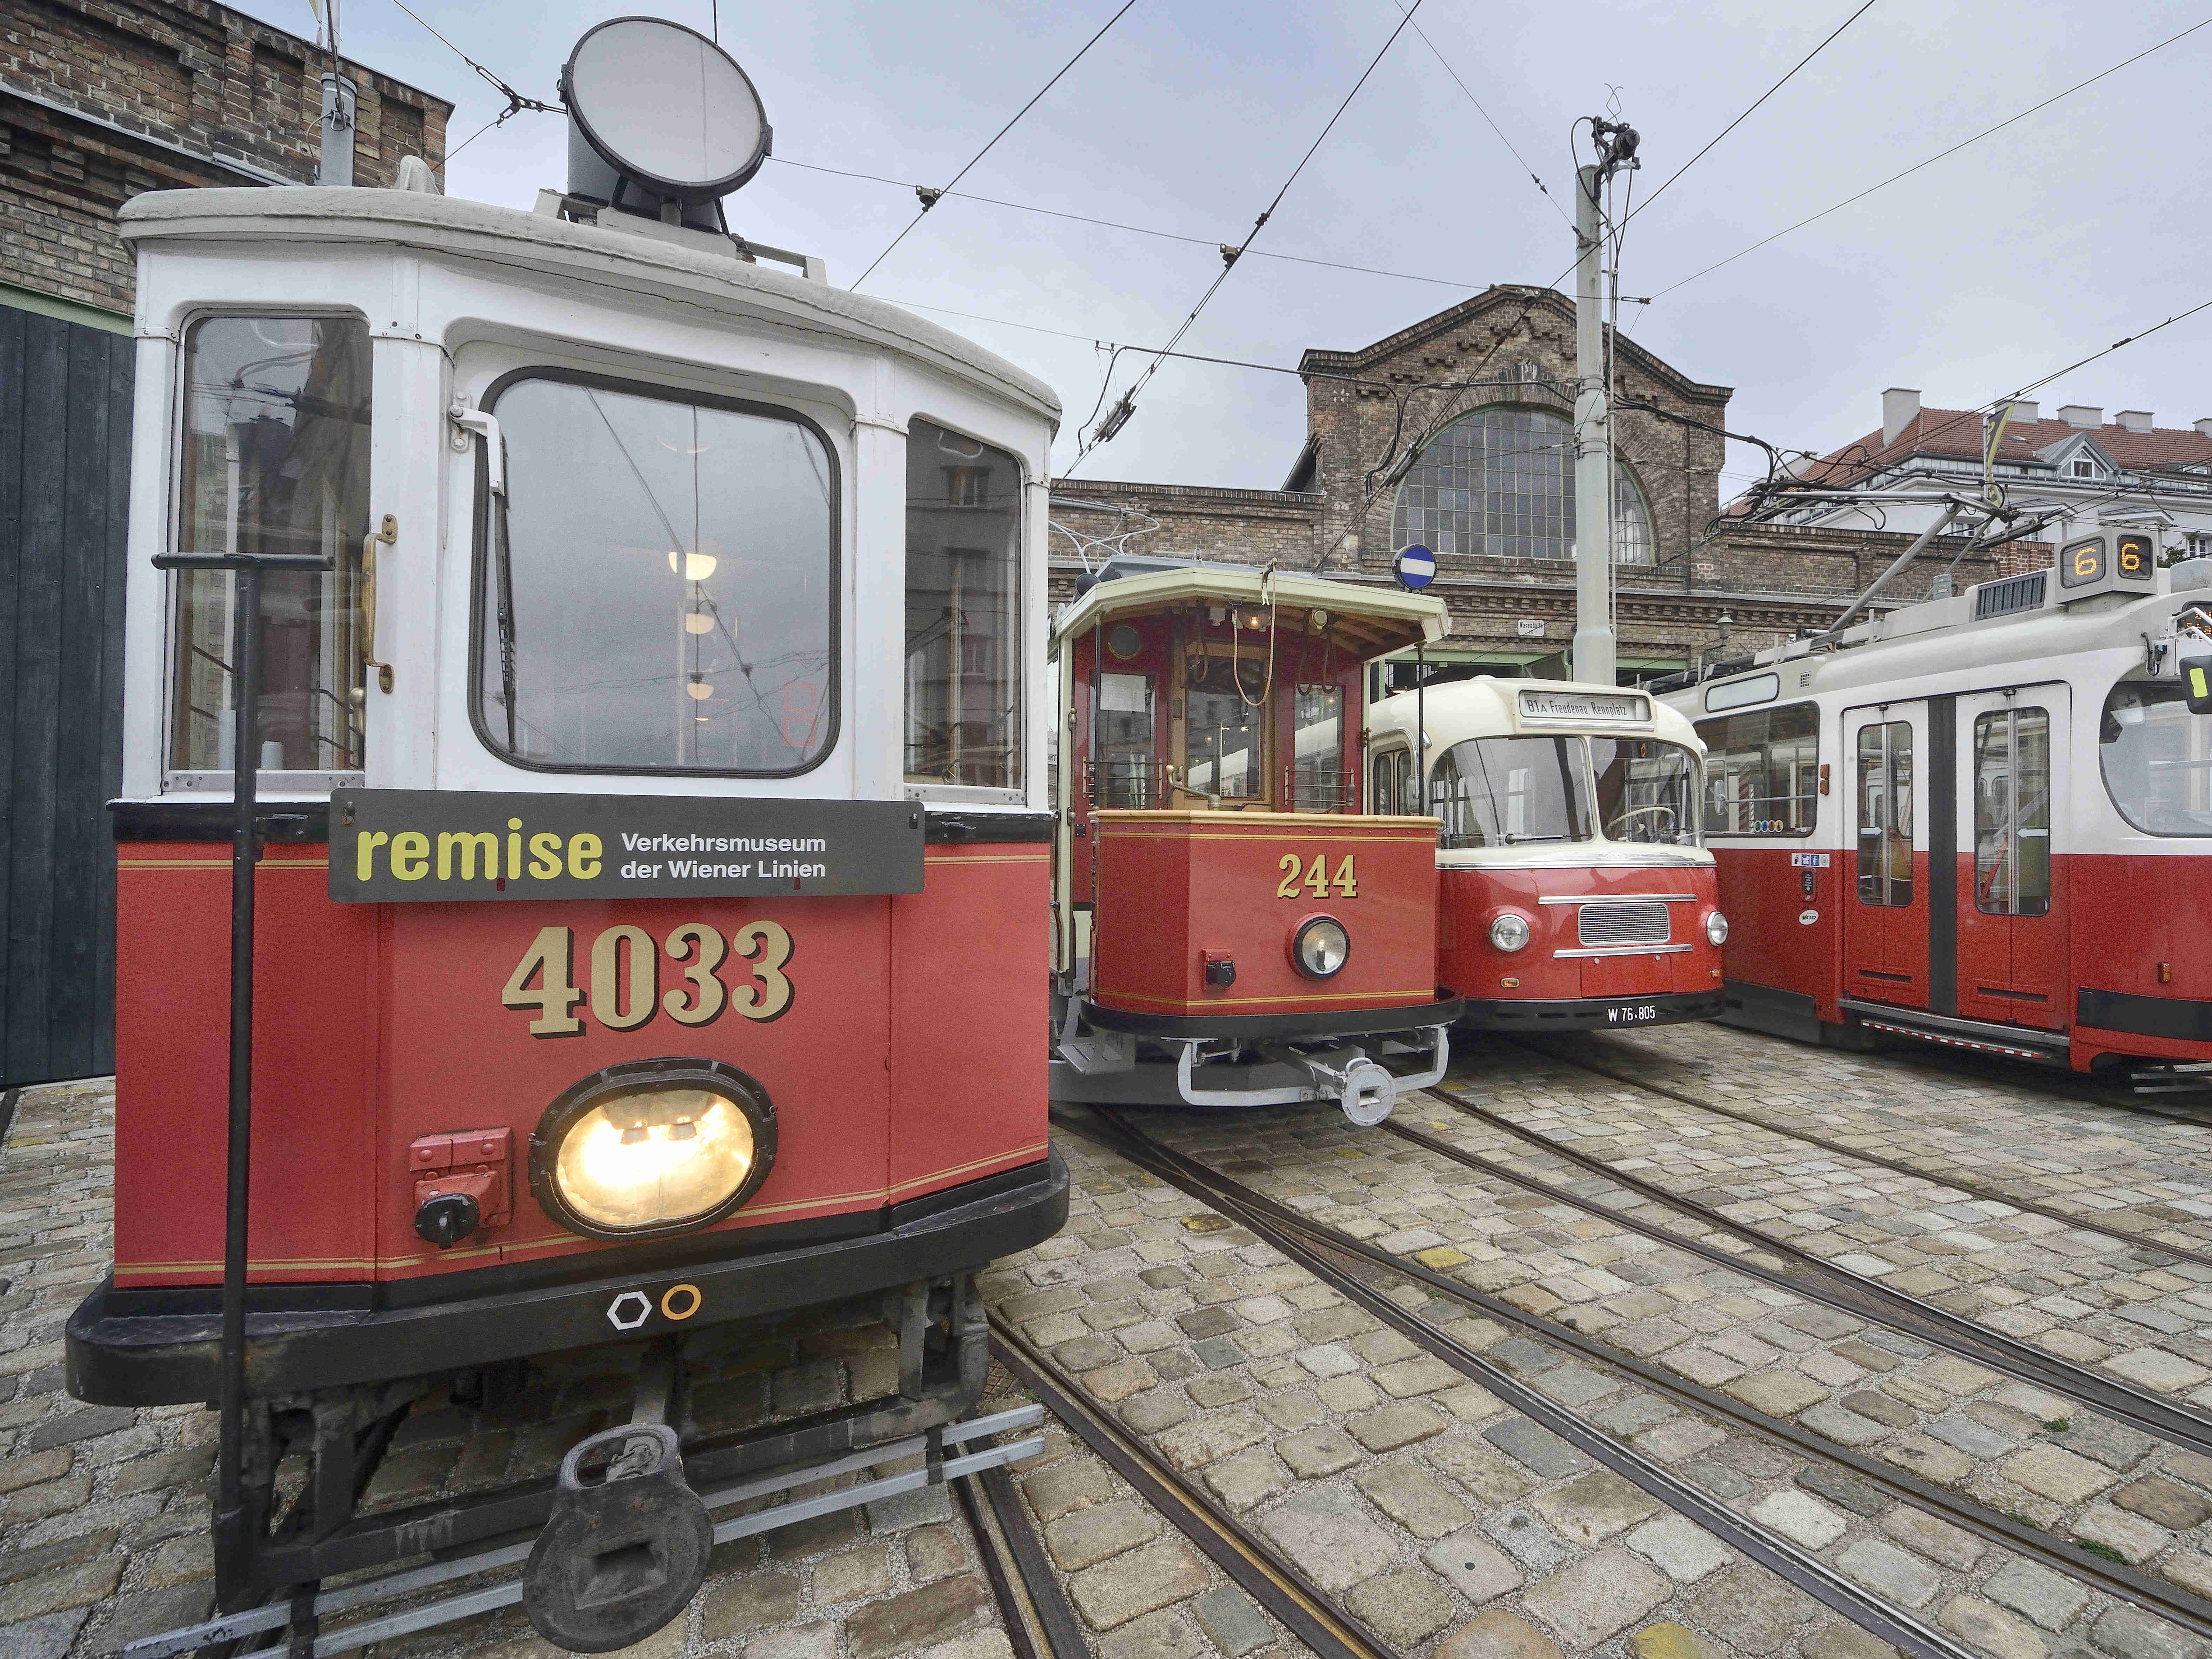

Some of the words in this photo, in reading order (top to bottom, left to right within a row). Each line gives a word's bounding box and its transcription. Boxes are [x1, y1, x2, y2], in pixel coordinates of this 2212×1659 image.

[2075, 547, 2097, 577] 6
[2121, 543, 2139, 571] 6
[1591, 701, 1627, 717] Rennplatz
[357, 818, 602, 881] remise
[621, 833, 826, 852] Verkehrsmuseum
[620, 859, 665, 879] der
[669, 860, 753, 879] Wiener
[758, 860, 825, 878] Linien
[1277, 853, 1358, 899] 244
[501, 920, 795, 1039] 4033
[1607, 1008, 1618, 1022] W
